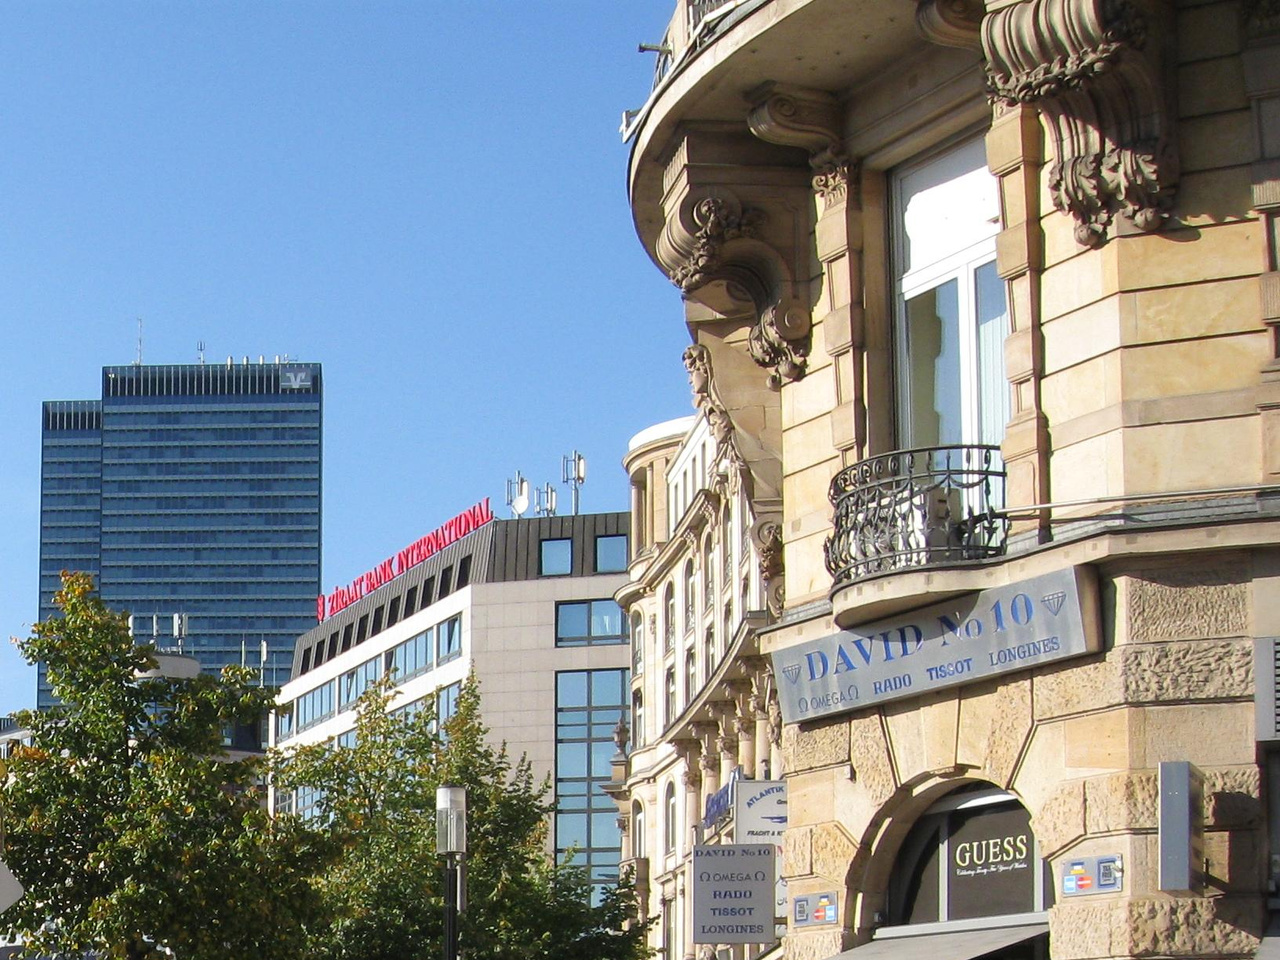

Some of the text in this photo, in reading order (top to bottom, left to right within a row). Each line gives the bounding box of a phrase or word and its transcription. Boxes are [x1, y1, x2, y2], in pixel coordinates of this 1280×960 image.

[364, 556, 396, 595] BANK
[397, 496, 495, 574] INTERNATIONAL
[804, 592, 1035, 682] DAVID No 10
[810, 691, 847, 710] OMEGA
[873, 673, 913, 695] RADO
[926, 657, 974, 682] TISSOT
[988, 635, 1061, 667] LONGINES
[746, 785, 785, 808] ATLANTIK
[695, 849, 736, 857] DAVID
[741, 849, 755, 857] No
[757, 848, 770, 857] 10
[955, 834, 1028, 867] GUESS
[713, 873, 752, 882] OMEGA
[712, 890, 753, 899] RADO
[710, 907, 755, 917] TISSOT
[701, 924, 764, 934] LONGINES
